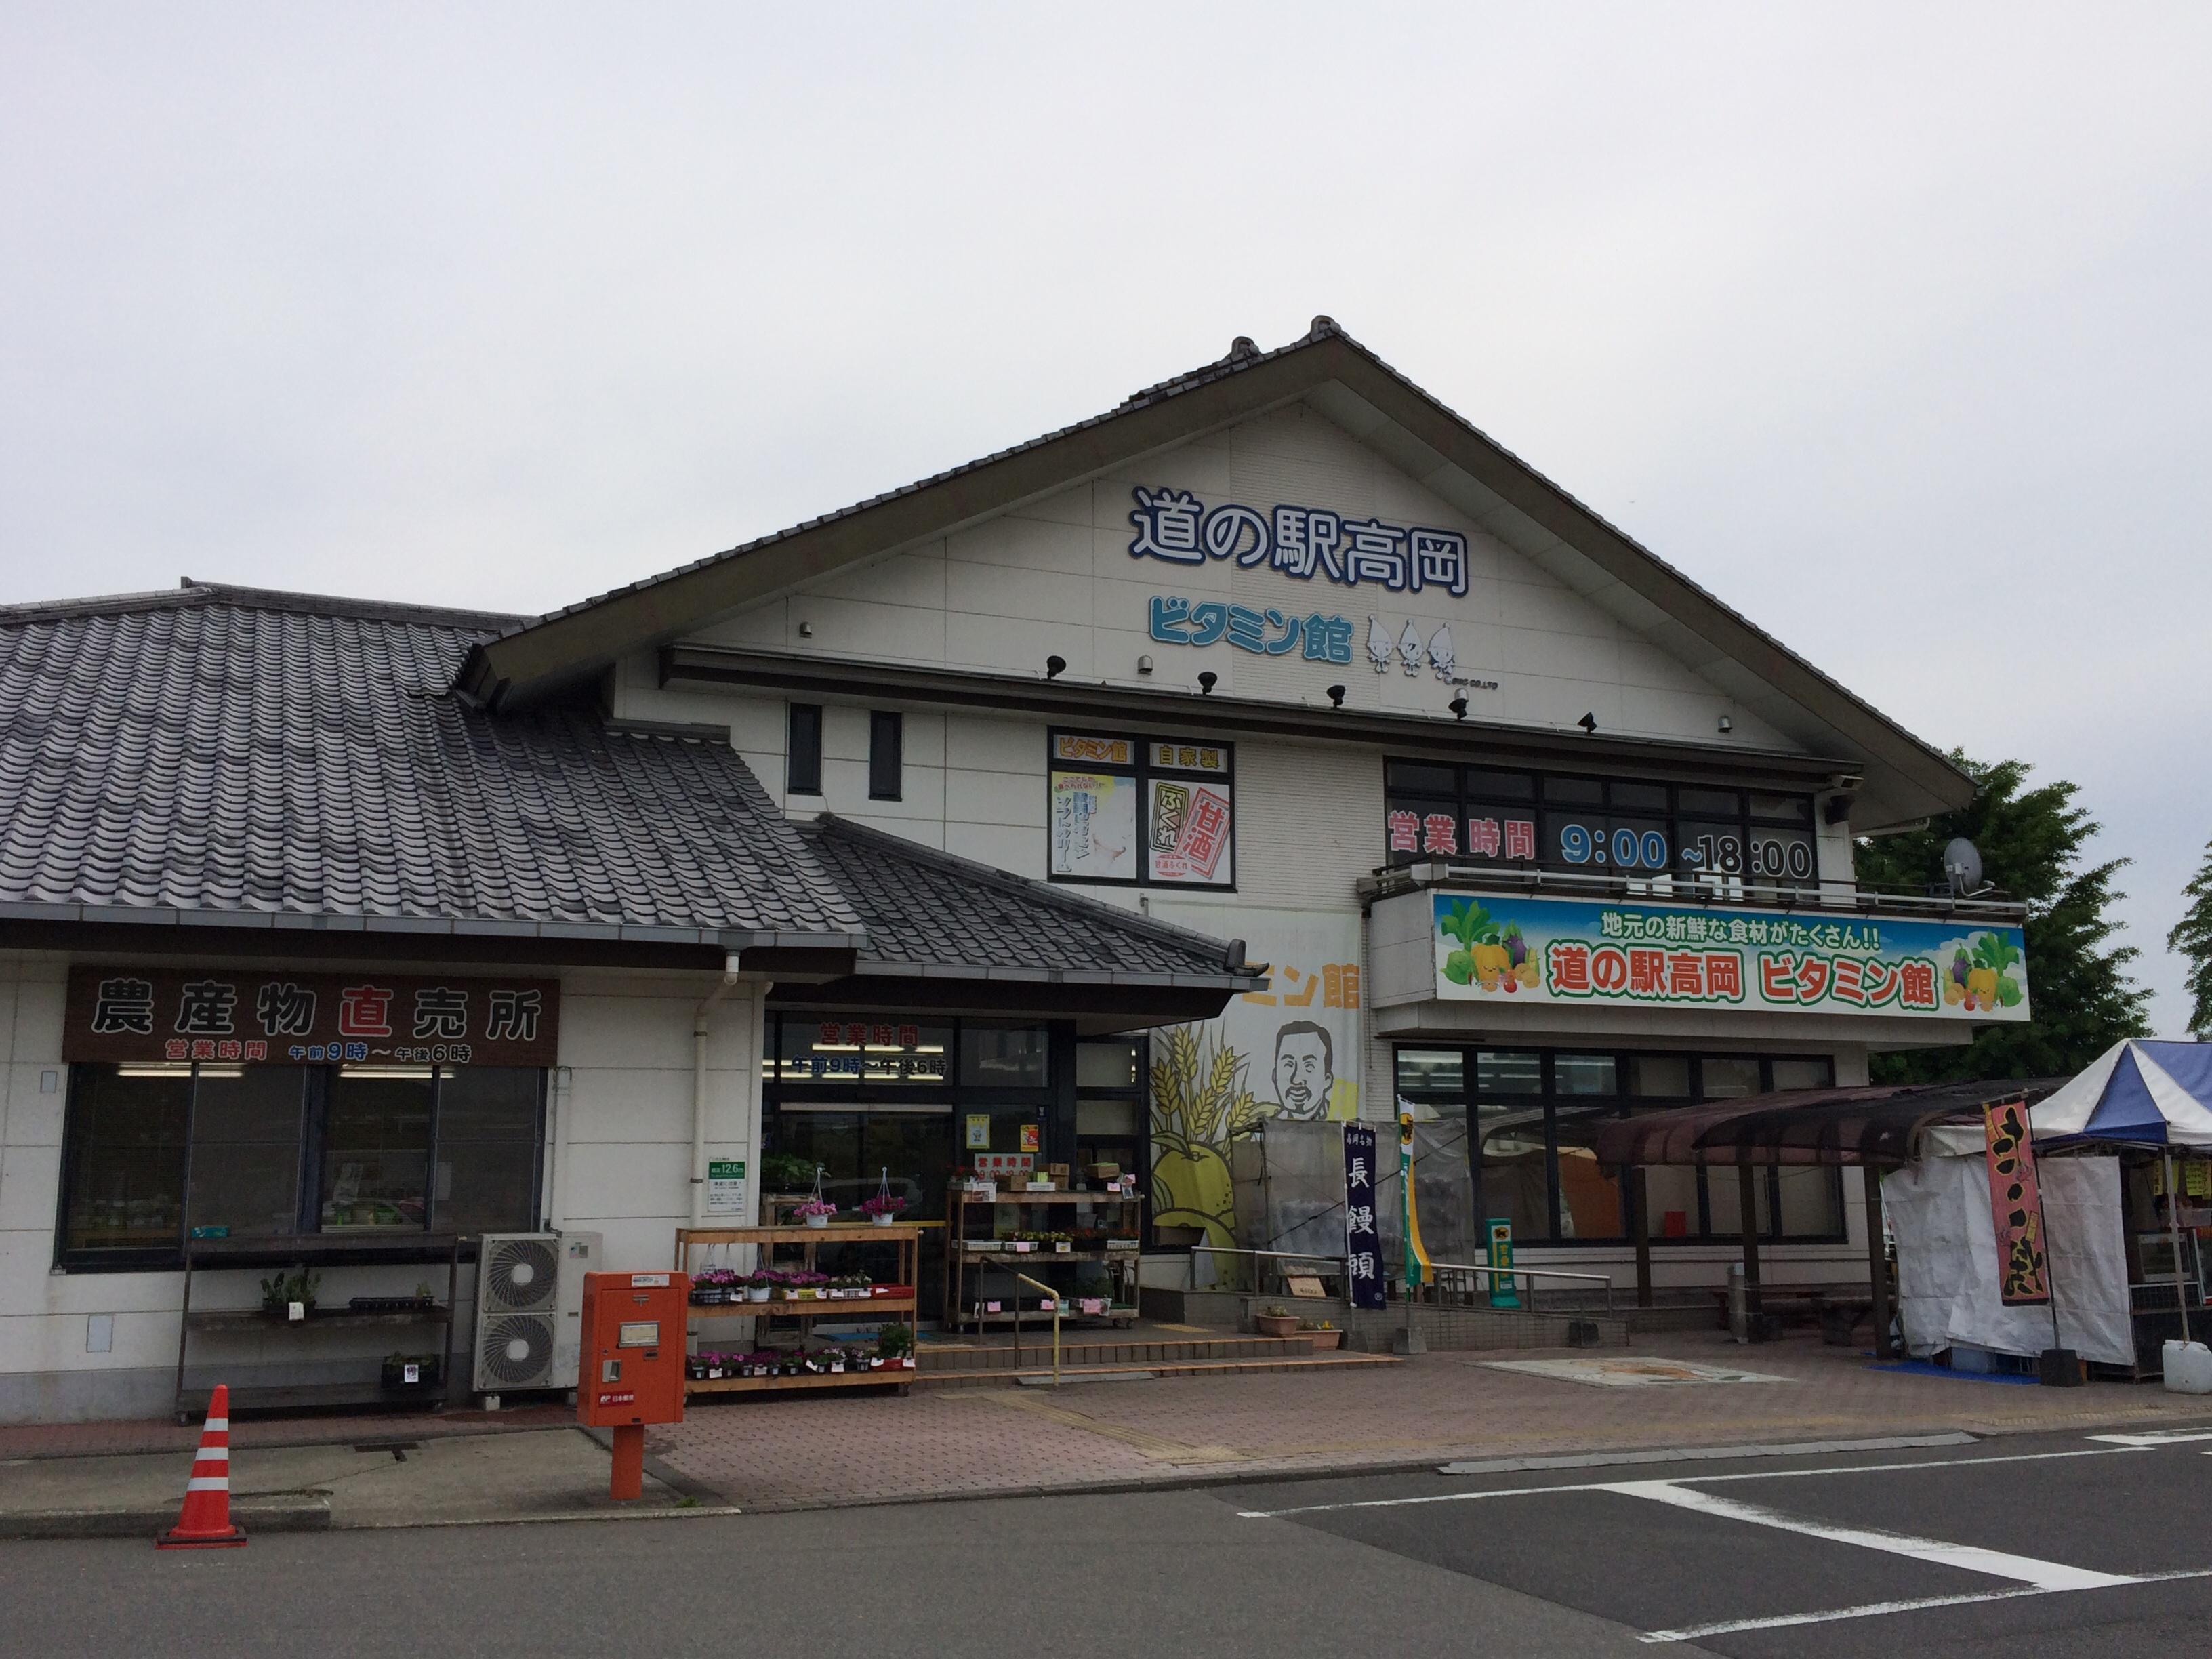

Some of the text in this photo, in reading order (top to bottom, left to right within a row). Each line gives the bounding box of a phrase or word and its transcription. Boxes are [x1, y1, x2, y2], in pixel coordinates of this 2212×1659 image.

[1129, 486, 1468, 598] 道の駅高岡
[1149, 595, 1353, 665] ビタミン館
[1059, 737, 1128, 763] ビタミン館
[1159, 745, 1219, 769] 自家製
[1156, 790, 1181, 846] ふくれ
[1183, 801, 1225, 863] 甘酒
[1388, 811, 1534, 861] 営業時間
[1601, 912, 1881, 949] 地元の新鮮な食材がたくさん!!
[1548, 942, 1938, 1007] 道の駅高岡 ビタミン館
[91, 977, 541, 1041] 農産物直売所
[820, 1022, 919, 1046] 営業時間
[164, 1038, 267, 1061] 営業時間
